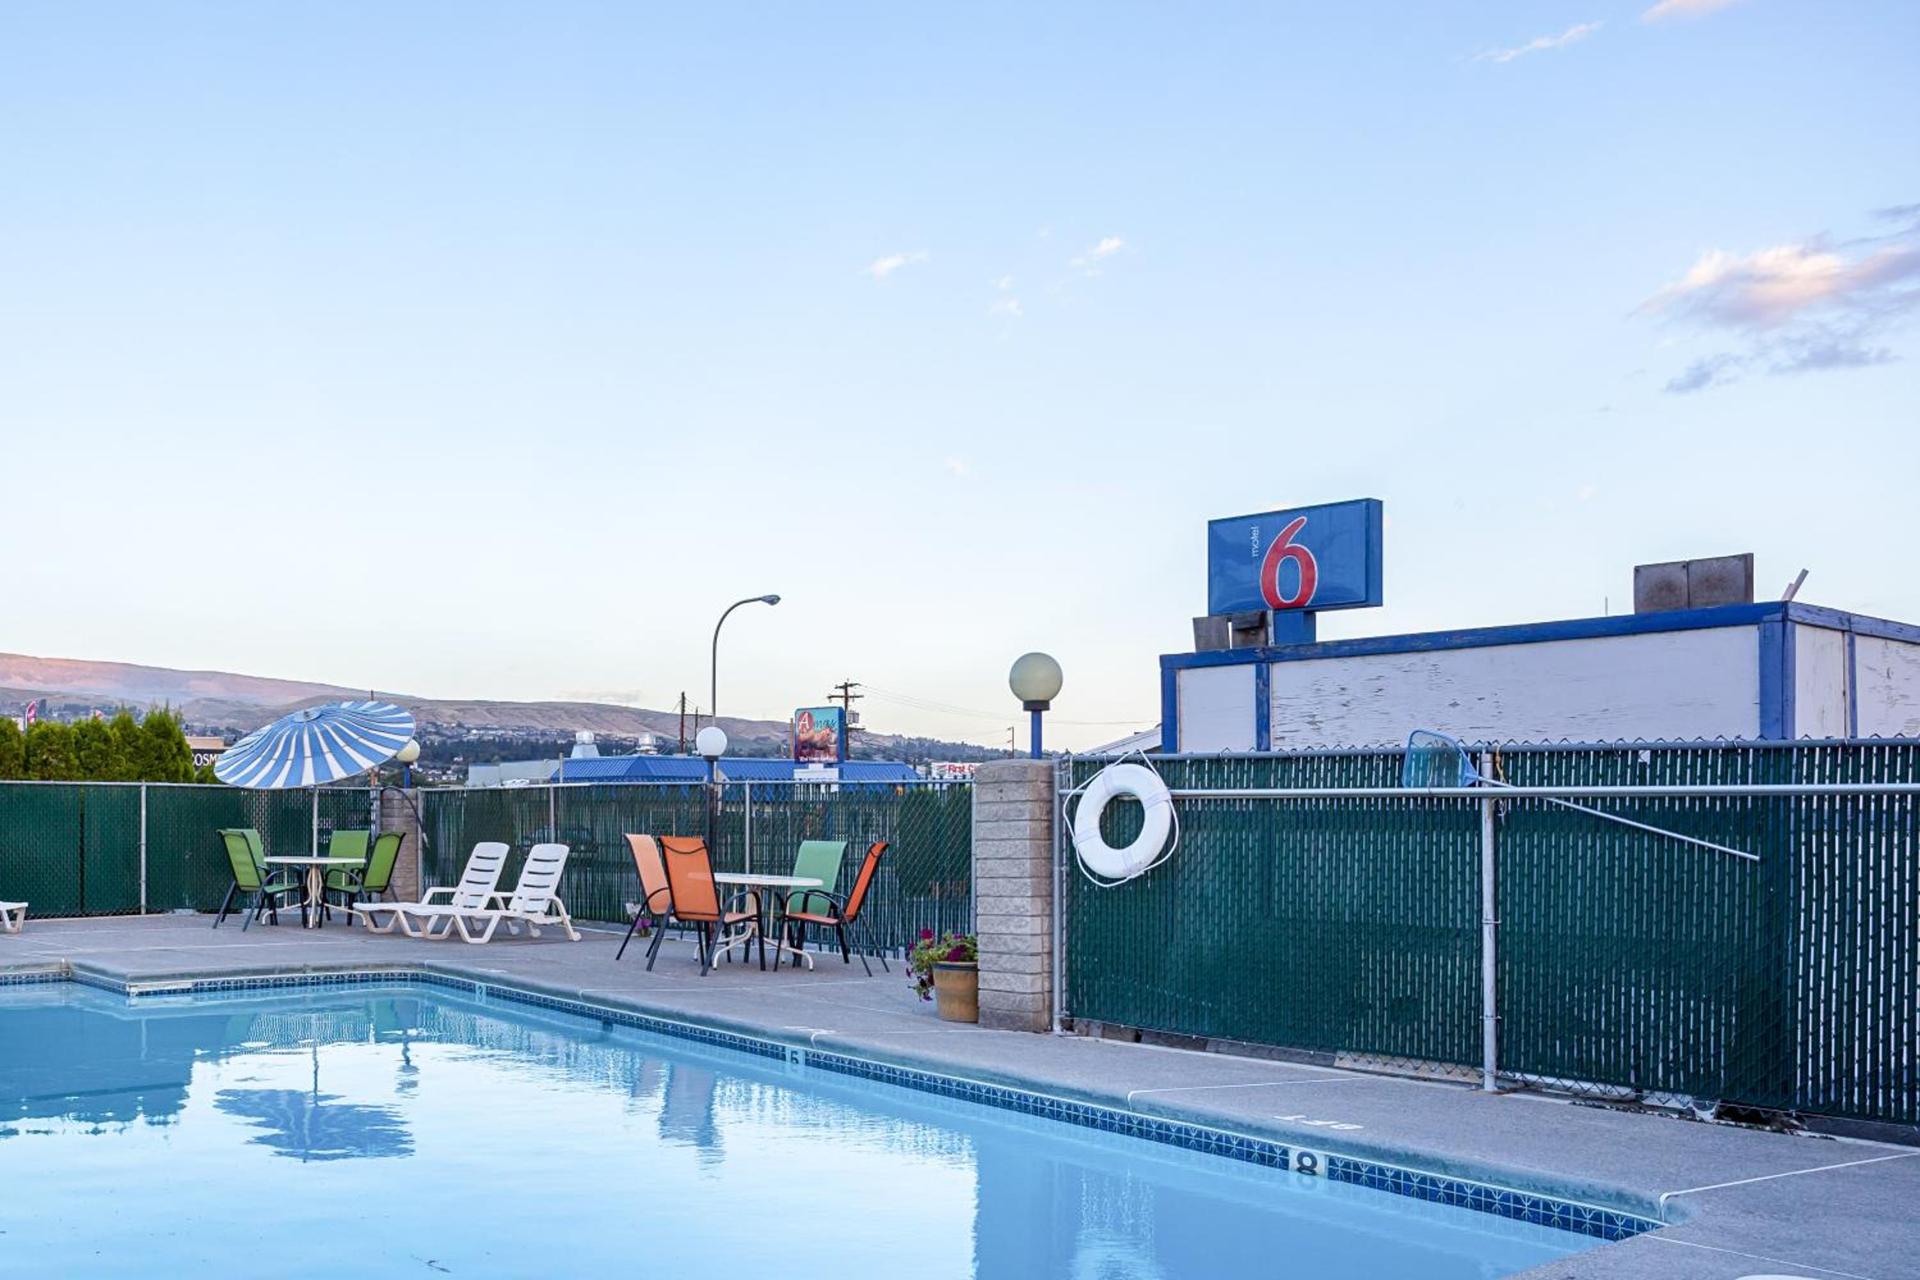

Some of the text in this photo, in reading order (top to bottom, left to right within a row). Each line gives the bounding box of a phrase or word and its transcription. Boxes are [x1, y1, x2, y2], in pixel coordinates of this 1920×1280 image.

[1251, 516, 1318, 609] motel 6
[1296, 1151, 1318, 1176] 8
